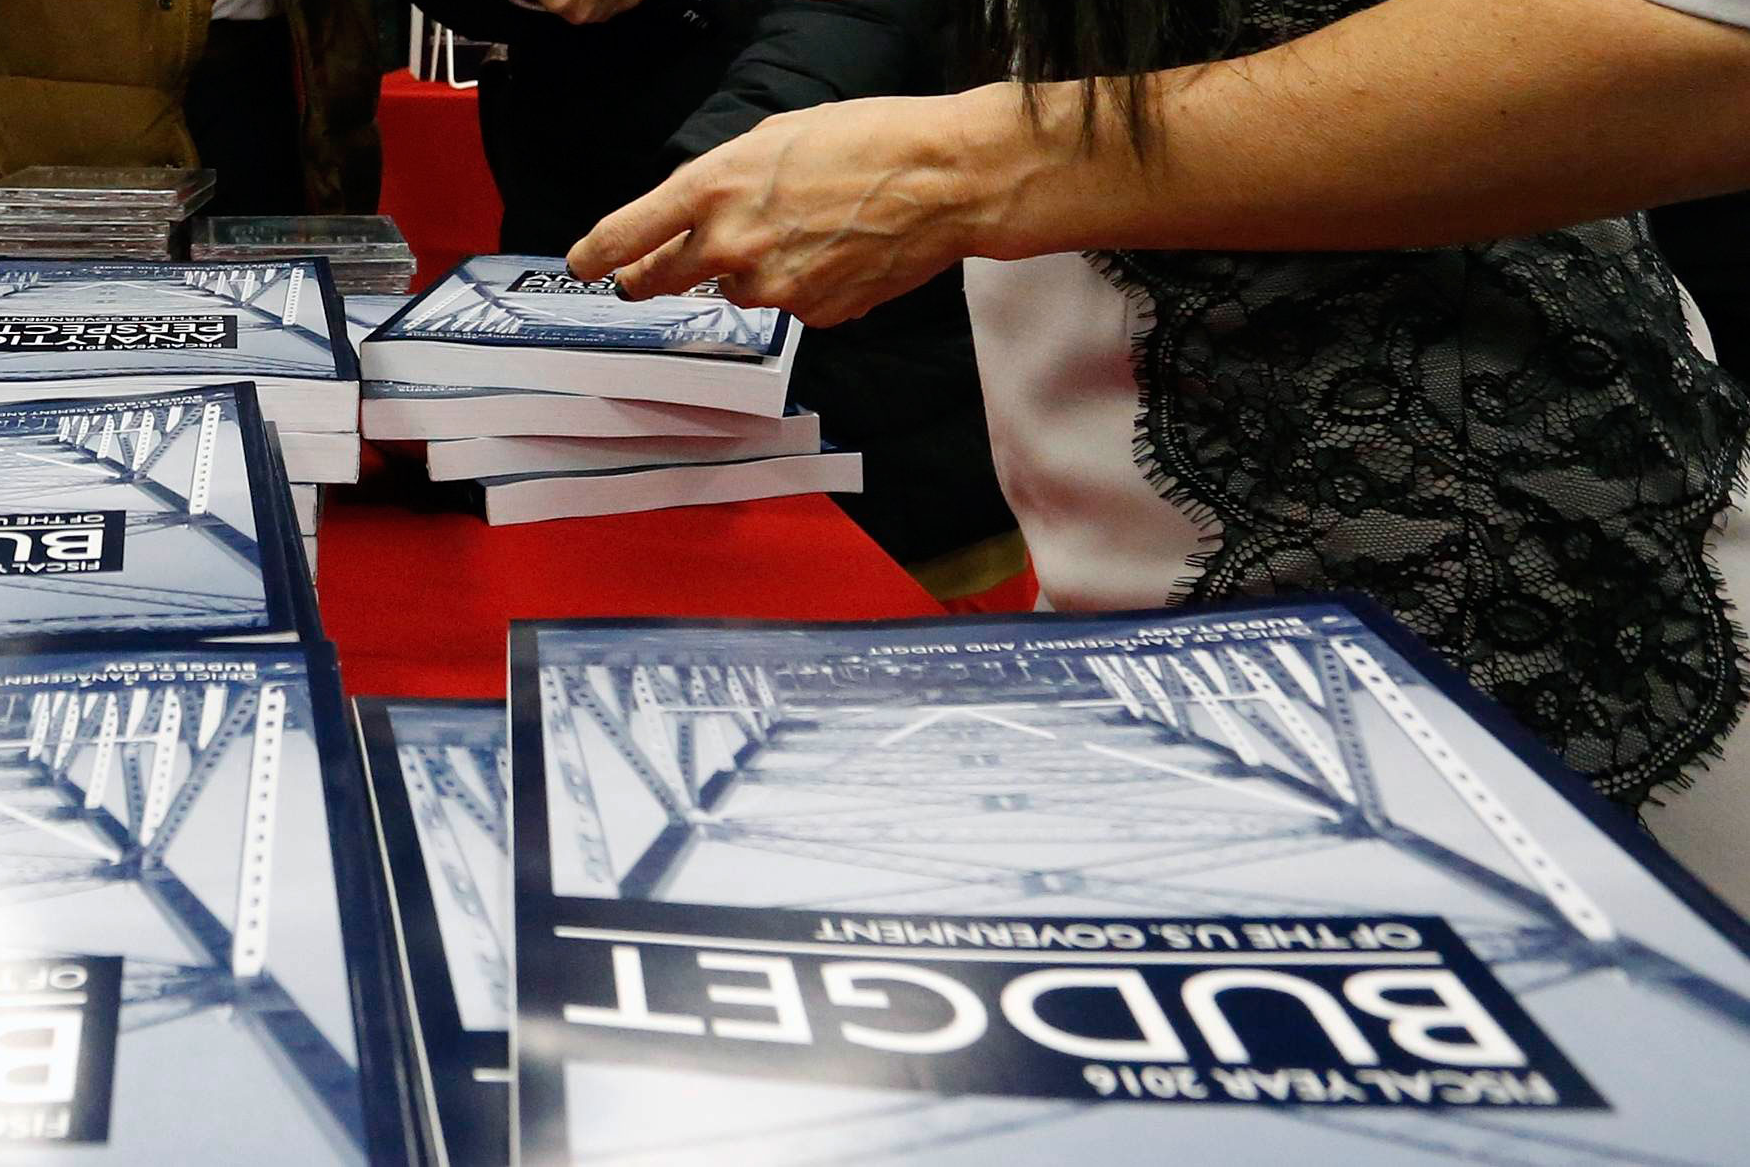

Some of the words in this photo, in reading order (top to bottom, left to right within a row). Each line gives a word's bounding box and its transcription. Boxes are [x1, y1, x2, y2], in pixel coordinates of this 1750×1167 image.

[17, 515, 66, 526] THE
[70, 514, 105, 524] OF
[12, 560, 101, 572] FISCAL
[1136, 617, 1305, 638] BUDGET.GOV
[1194, 631, 1221, 643] OF
[1223, 625, 1313, 640] OFFICE
[869, 644, 959, 656] BUDGET
[964, 641, 1016, 653] AND
[1025, 633, 1188, 652] MANAGEMENT
[104, 663, 257, 673] BUDGET.GOV
[149, 673, 178, 683] OF
[183, 673, 258, 683] OFFICE
[814, 917, 1145, 949] GOVERNMENT
[1150, 923, 1238, 950] U.S.
[1242, 922, 1350, 950] THE
[1351, 922, 1423, 950] OF
[27, 965, 91, 991] OF
[563, 945, 1527, 1066] BUDGET
[1082, 1064, 1208, 1100] 2016
[1211, 1067, 1367, 1103] YEAR
[1358, 1068, 1559, 1106] FISCAL
